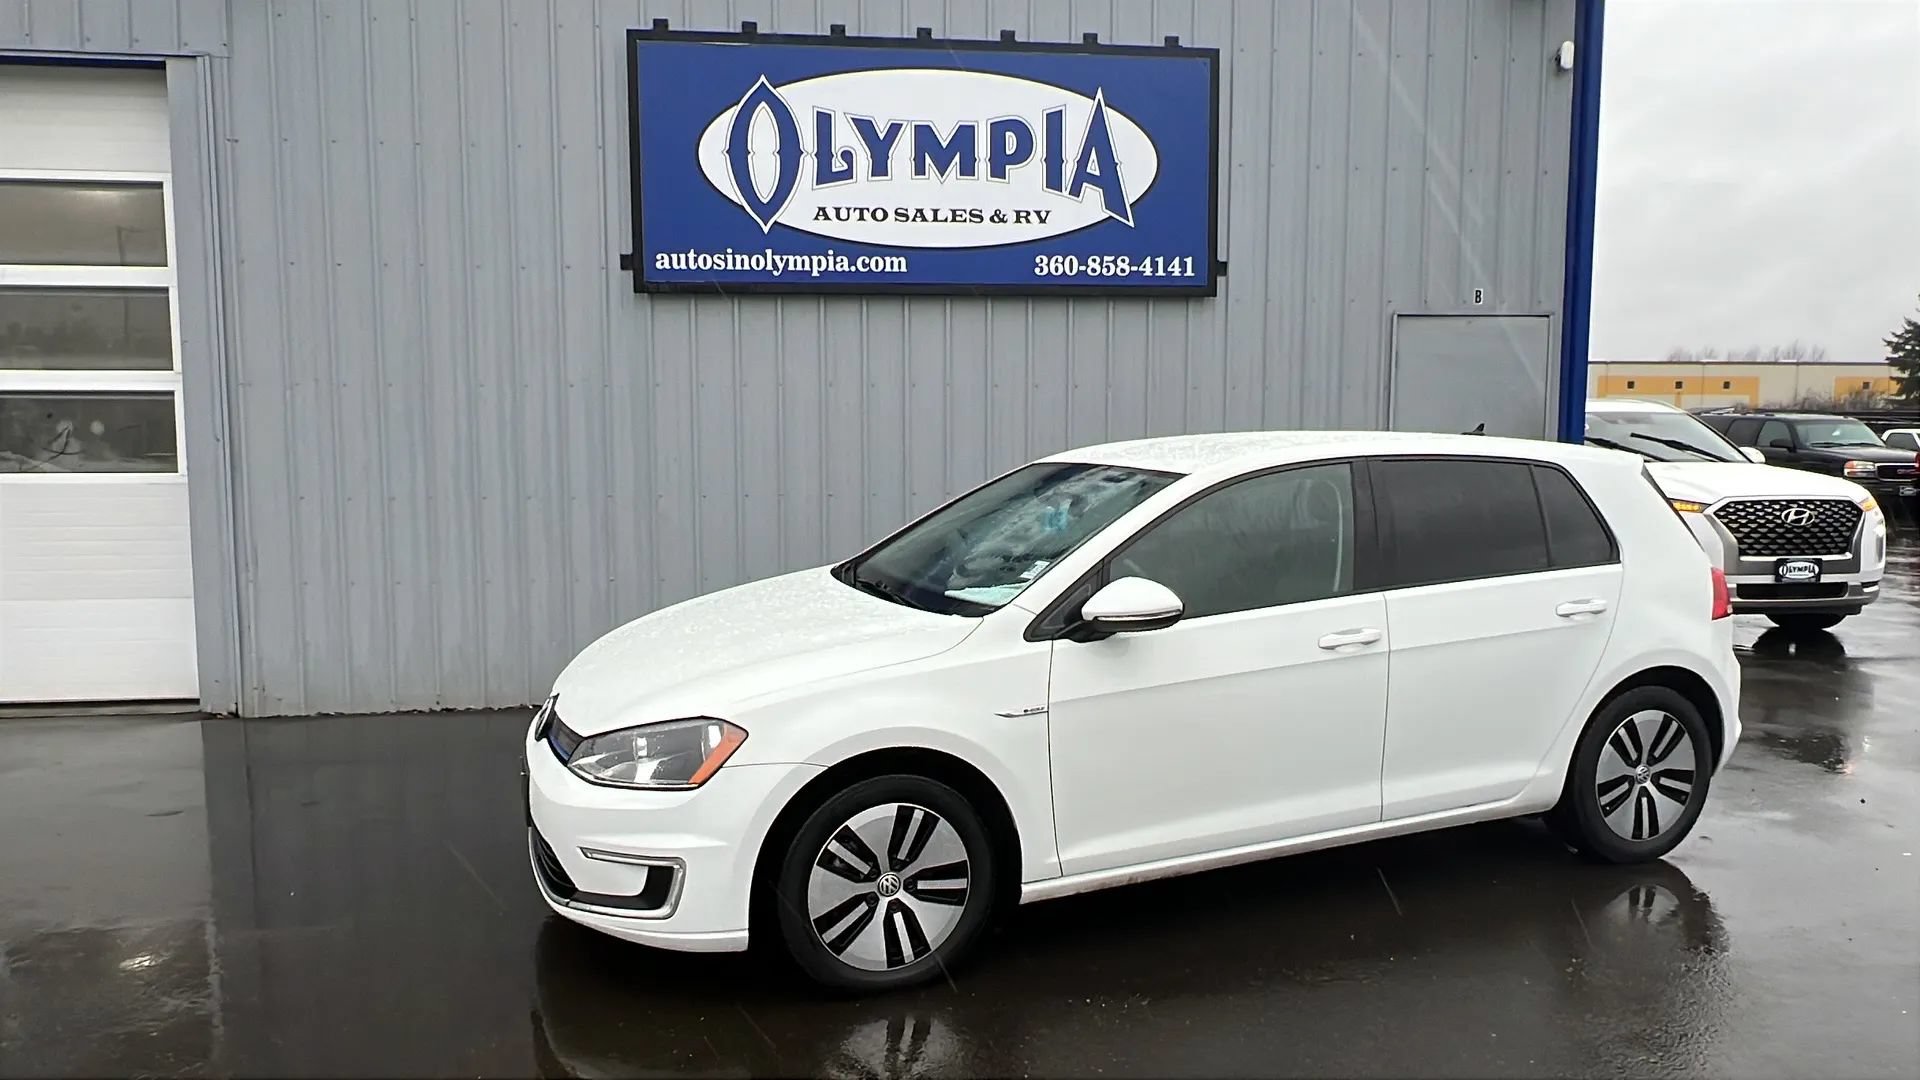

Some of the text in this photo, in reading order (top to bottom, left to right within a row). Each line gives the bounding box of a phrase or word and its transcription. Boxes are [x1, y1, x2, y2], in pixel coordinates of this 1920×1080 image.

[725, 76, 1133, 231] OLYMPIA
[813, 206, 1052, 224] AUTO SALES & RV
[655, 248, 908, 277] autosinolympia.com
[1034, 255, 1195, 277] 360-858-4141
[1474, 289, 1482, 304] B
